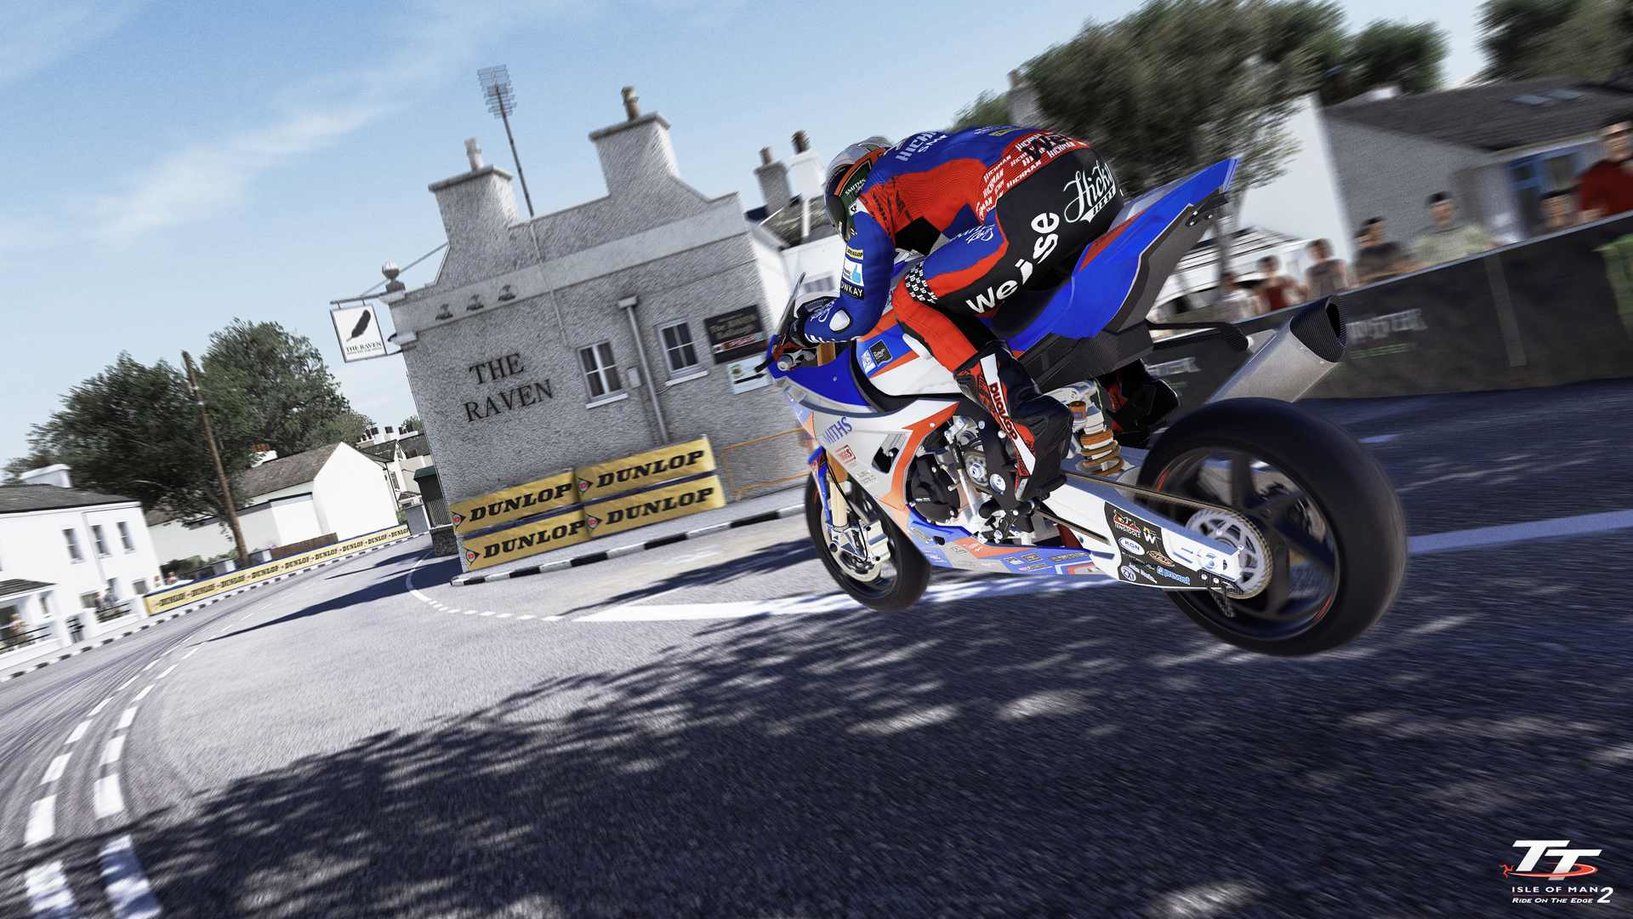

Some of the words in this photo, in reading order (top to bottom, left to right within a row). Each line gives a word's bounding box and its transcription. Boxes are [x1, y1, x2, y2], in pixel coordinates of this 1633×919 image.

[468, 352, 524, 385] THE
[463, 379, 554, 423] RAVEN
[596, 450, 705, 489] DUNLOP
[469, 482, 572, 523] DUNLOP
[606, 487, 714, 526] DUNLOP
[284, 556, 310, 570] DUNLOP
[315, 548, 338, 561] DUNLOP
[342, 541, 364, 553] DUNLOP
[483, 520, 586, 559] DUNLOP
